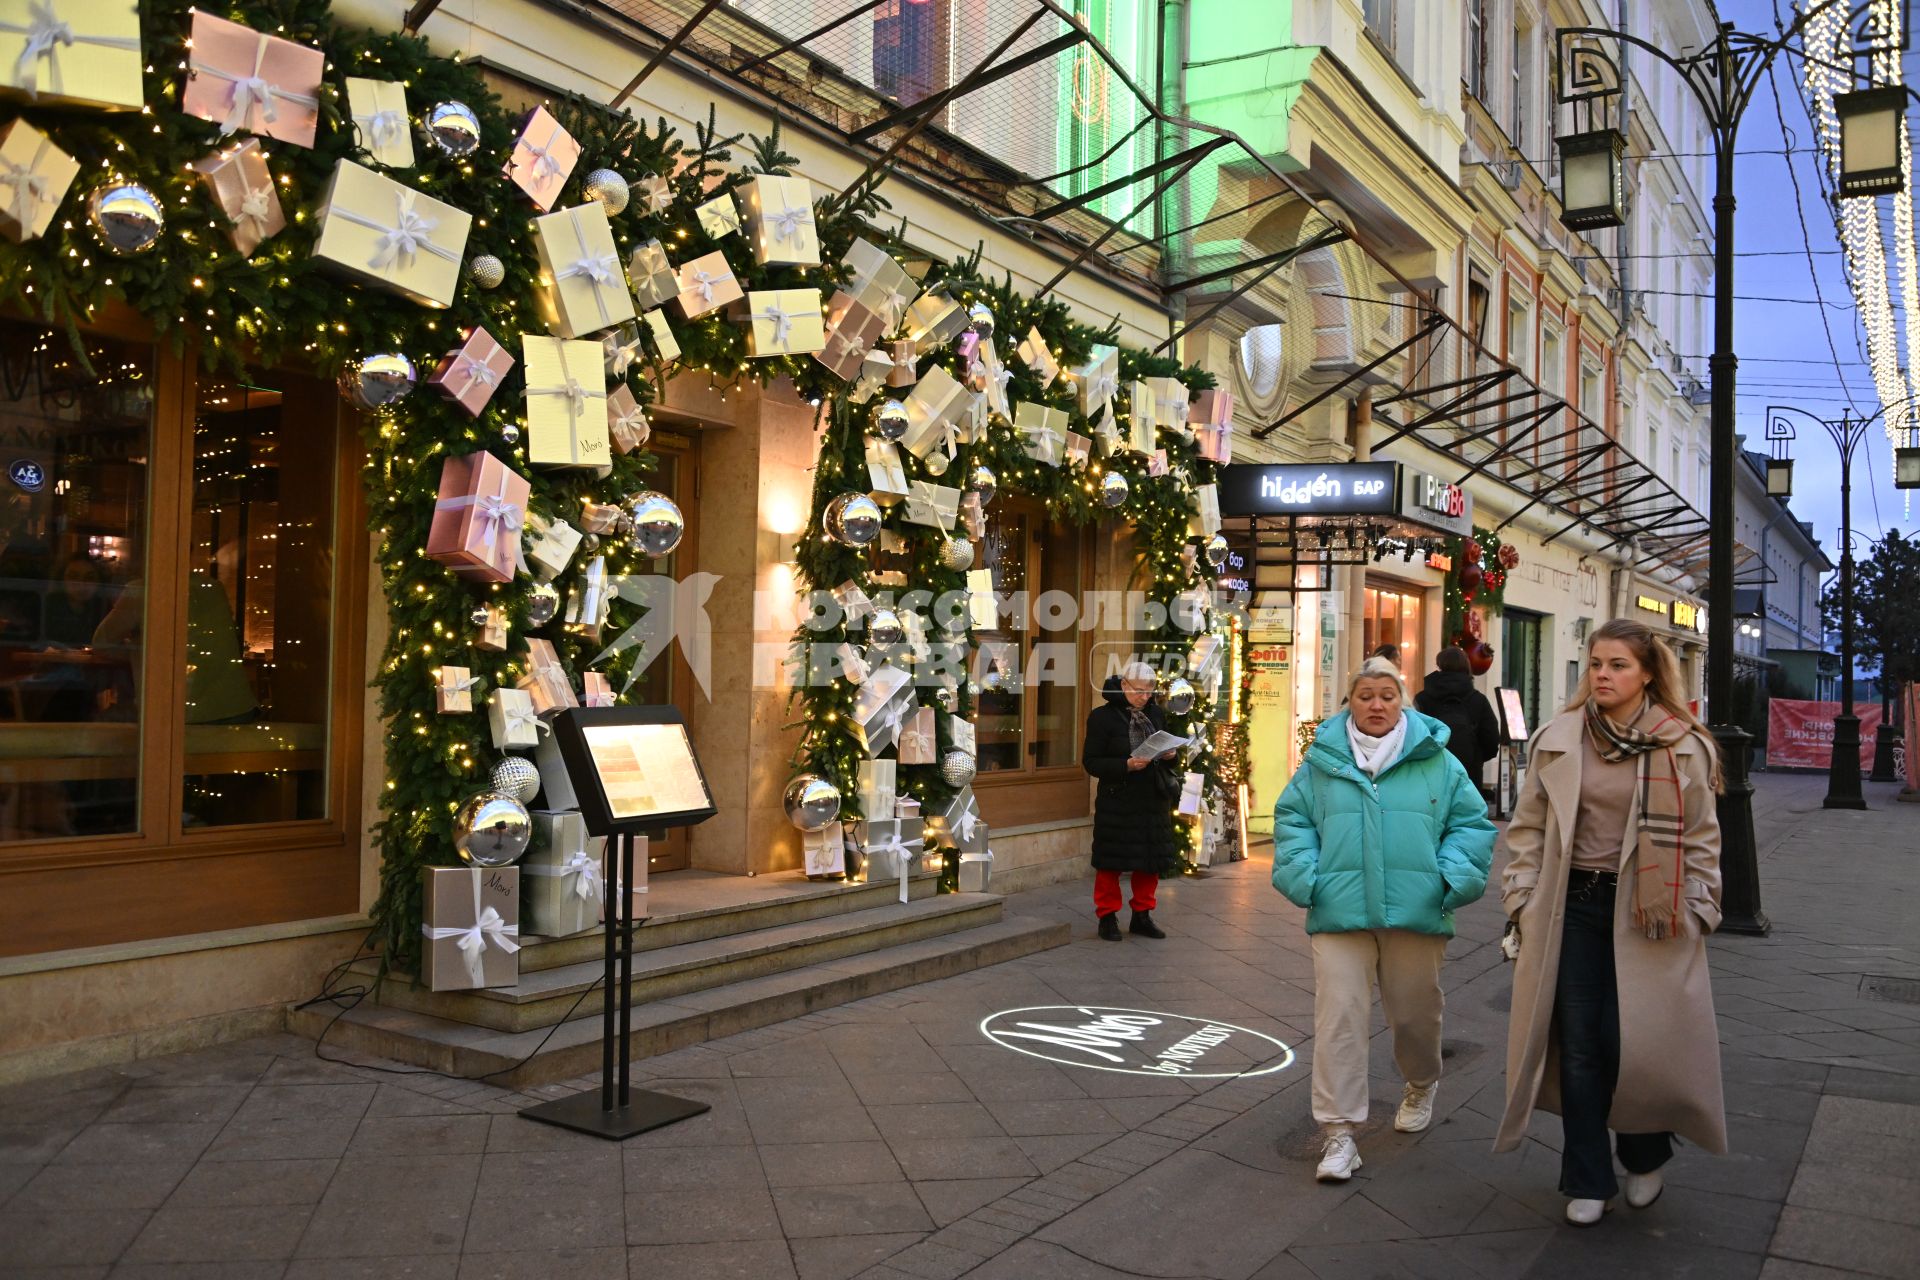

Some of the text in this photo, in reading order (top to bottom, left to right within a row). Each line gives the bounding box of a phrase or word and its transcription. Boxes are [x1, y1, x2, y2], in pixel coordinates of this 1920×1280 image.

[1353, 480, 1385, 495] БАР
[1229, 551, 1244, 571] бар
[1228, 577, 1249, 593] кафе
[1248, 649, 1287, 661] ФОТО
[1322, 643, 1334, 665] 24
[1142, 1024, 1237, 1075] by NOVIKOV
